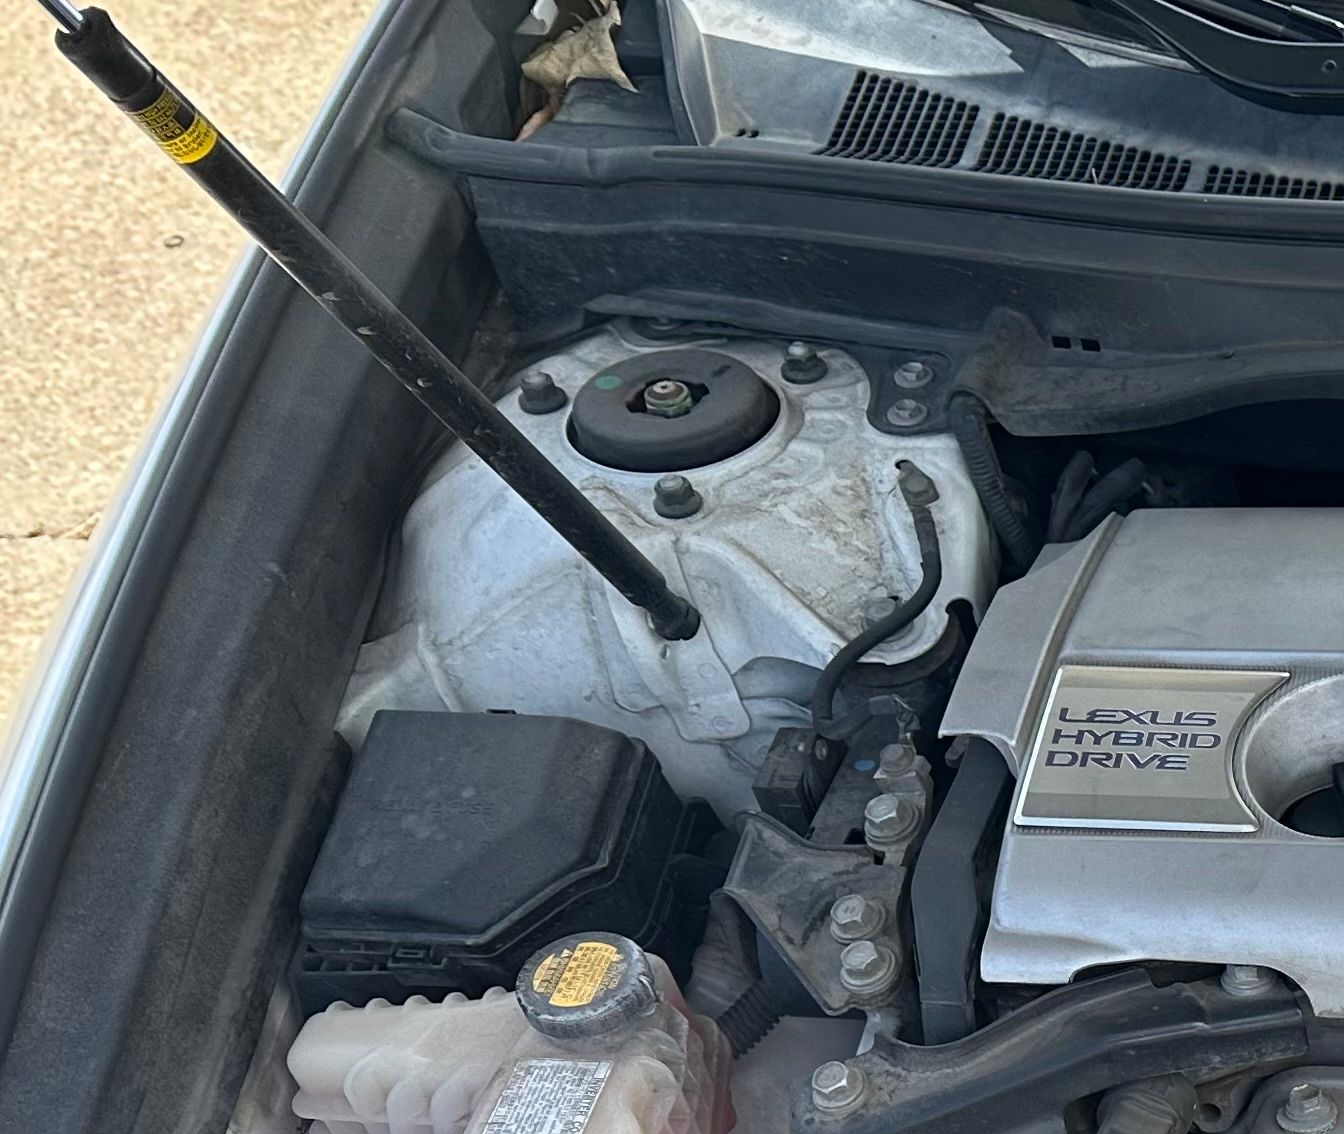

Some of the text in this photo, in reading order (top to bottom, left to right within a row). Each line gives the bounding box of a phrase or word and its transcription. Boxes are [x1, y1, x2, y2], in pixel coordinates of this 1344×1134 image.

[1058, 707, 1218, 727] LEXUS
[1051, 728, 1222, 749] HYBRID
[1045, 750, 1190, 770] DRIVE
